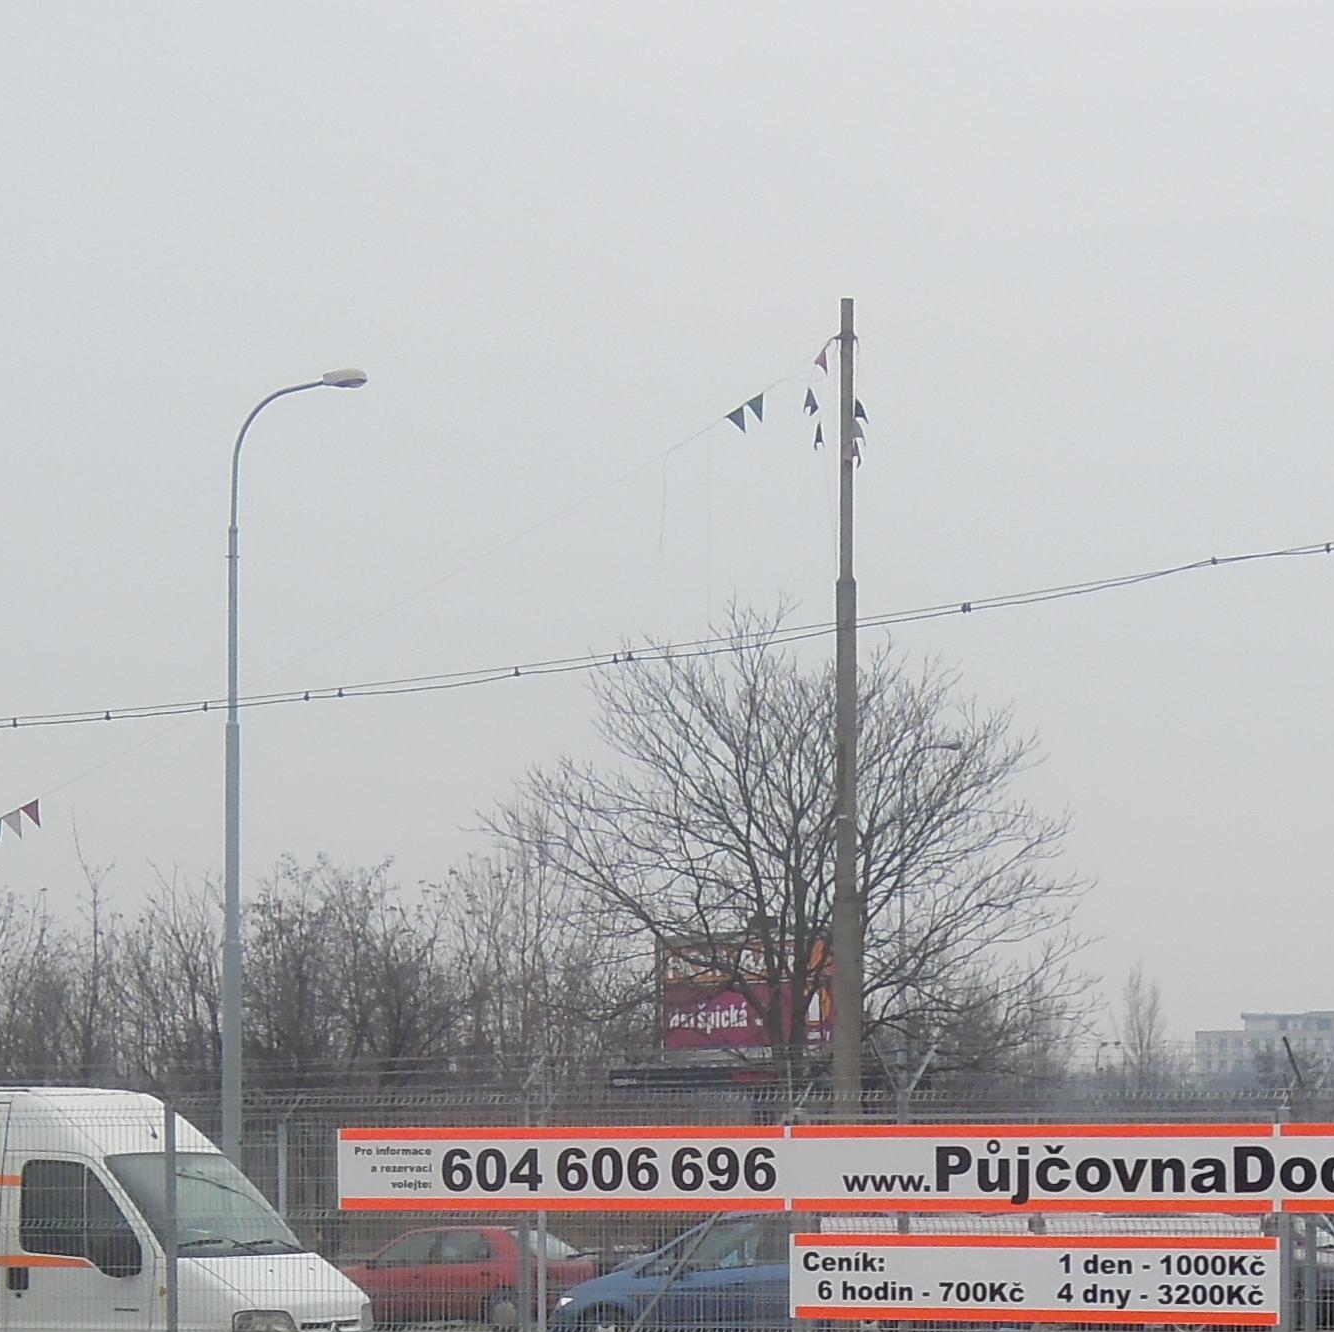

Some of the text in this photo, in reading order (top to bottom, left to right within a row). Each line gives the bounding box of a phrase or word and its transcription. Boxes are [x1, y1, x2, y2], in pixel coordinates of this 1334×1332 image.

[354, 1146, 432, 1155] Pro informace
[441, 1147, 776, 1192] 604 606 696
[391, 1180, 432, 1190] volejte:
[802, 1251, 885, 1273] Ceník:
[1058, 1254, 1071, 1274] 1
[1083, 1253, 1133, 1275] den
[1160, 1254, 1266, 1276] 1000Kč
[817, 1280, 832, 1301] 6
[843, 1280, 913, 1302] hodin
[939, 1281, 1024, 1303] 700Kč
[1057, 1283, 1073, 1303] 4
[1083, 1284, 1131, 1309] dny
[1158, 1284, 1264, 1305] 3200Kč
